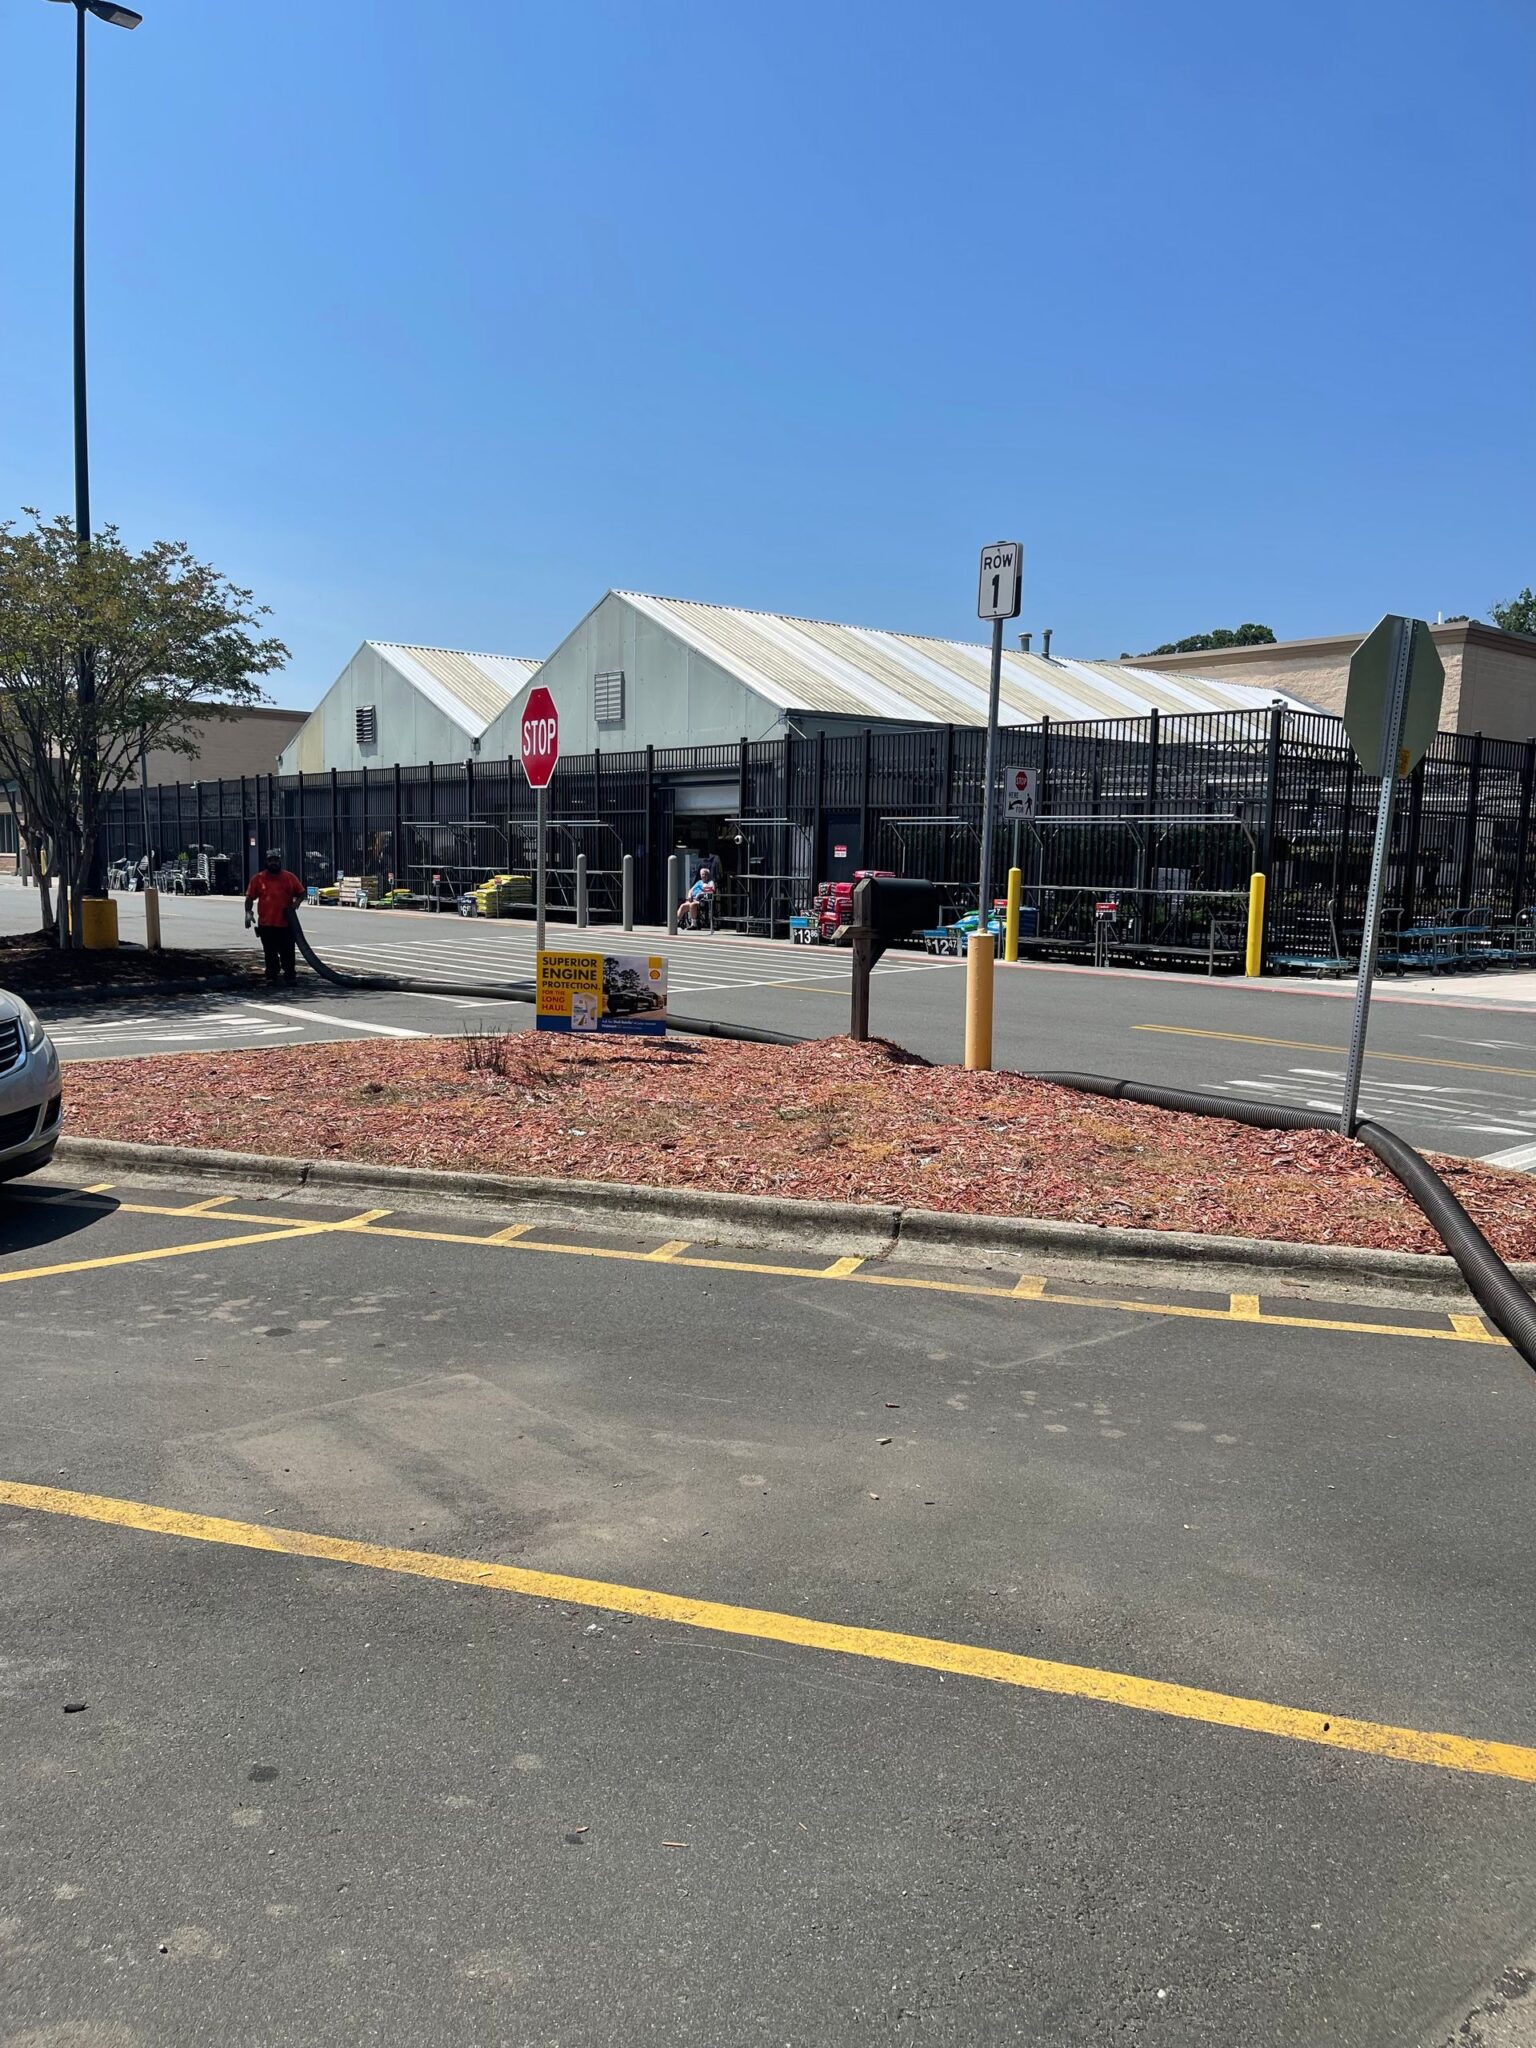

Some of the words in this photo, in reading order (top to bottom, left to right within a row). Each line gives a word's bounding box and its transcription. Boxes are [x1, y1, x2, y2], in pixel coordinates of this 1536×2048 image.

[984, 553, 1013, 570] ROW
[992, 574, 1000, 608] 1
[523, 719, 556, 756] STOP
[1016, 776, 1028, 785] STOP
[542, 956, 597, 967] SUPERIOR
[542, 967, 597, 981] ENGINE
